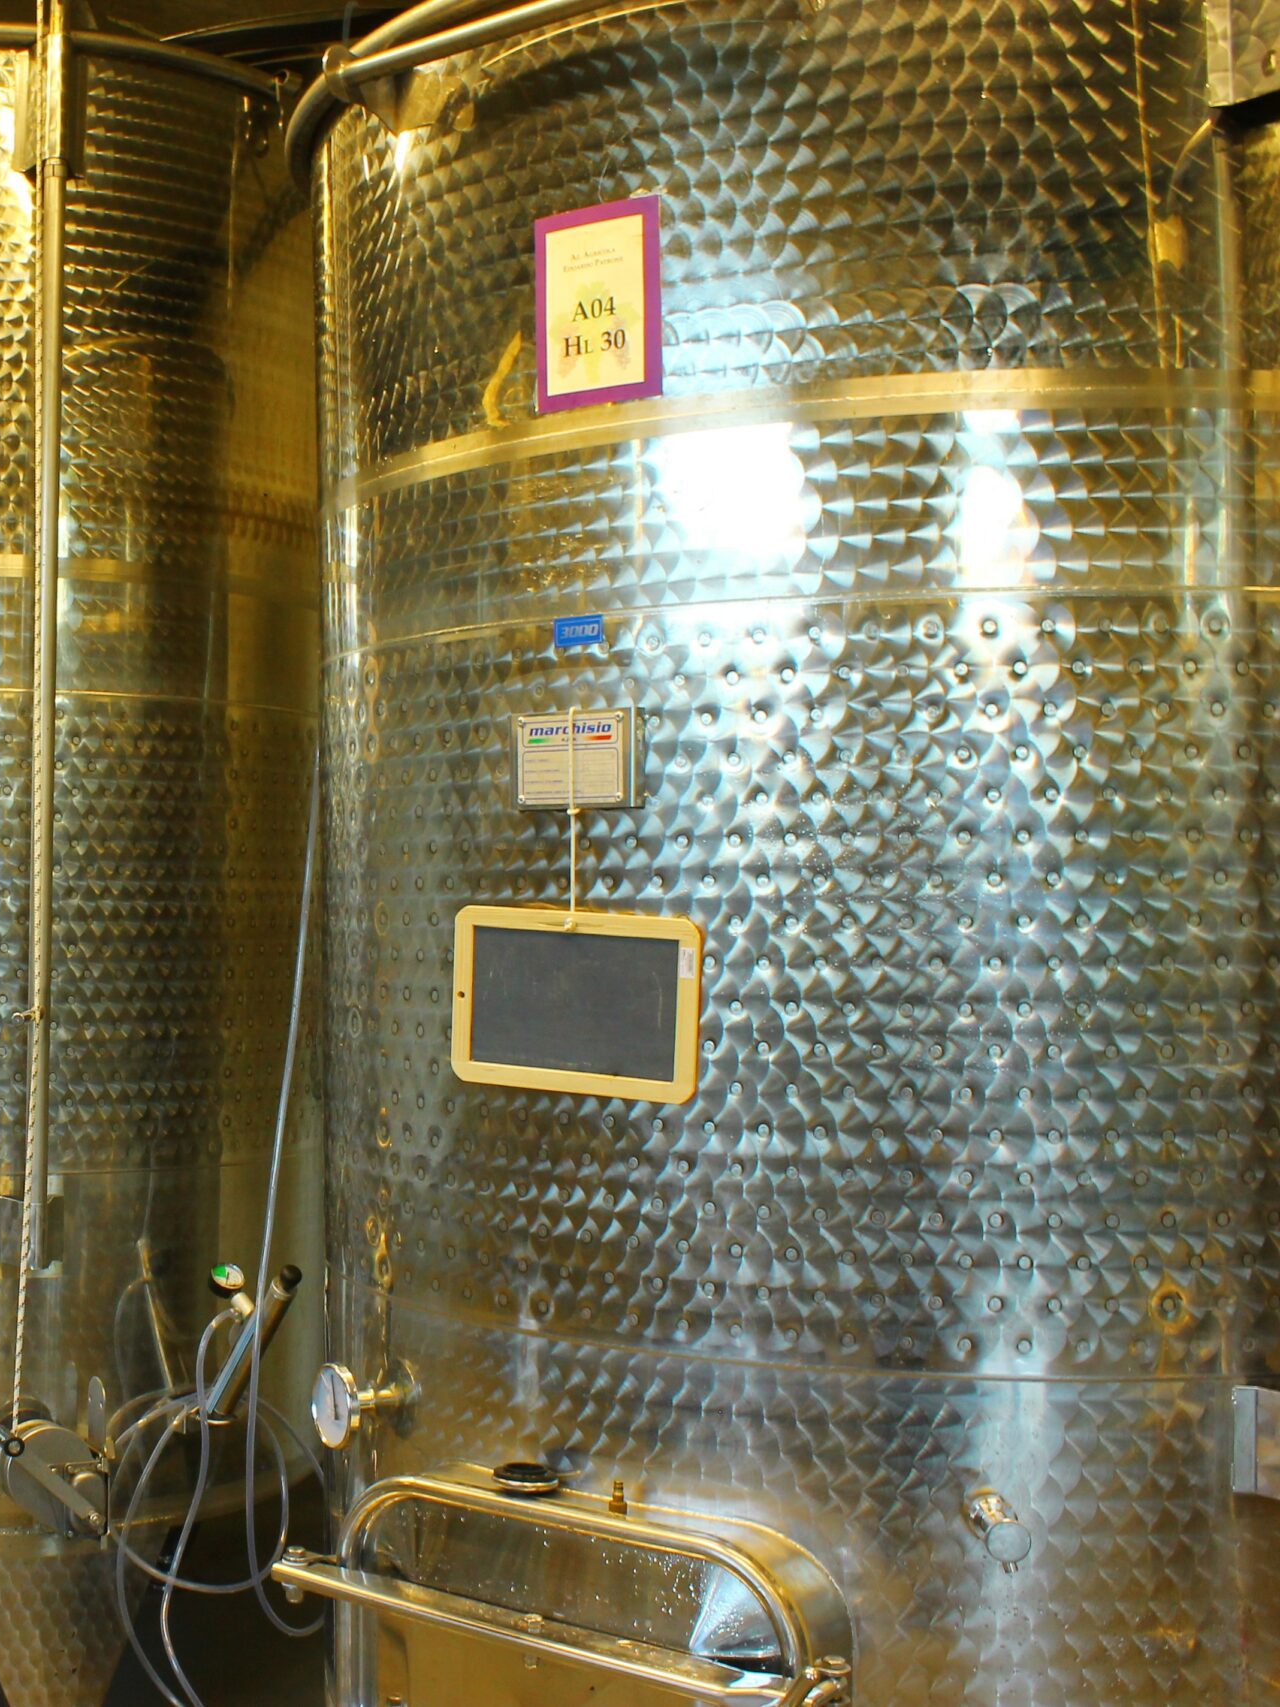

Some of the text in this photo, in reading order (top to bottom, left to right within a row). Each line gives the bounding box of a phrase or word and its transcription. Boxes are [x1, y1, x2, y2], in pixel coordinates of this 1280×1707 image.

[572, 296, 617, 322] A04
[601, 329, 626, 352] 30
[560, 624, 599, 639] 3000
[529, 721, 612, 737] marchisio
